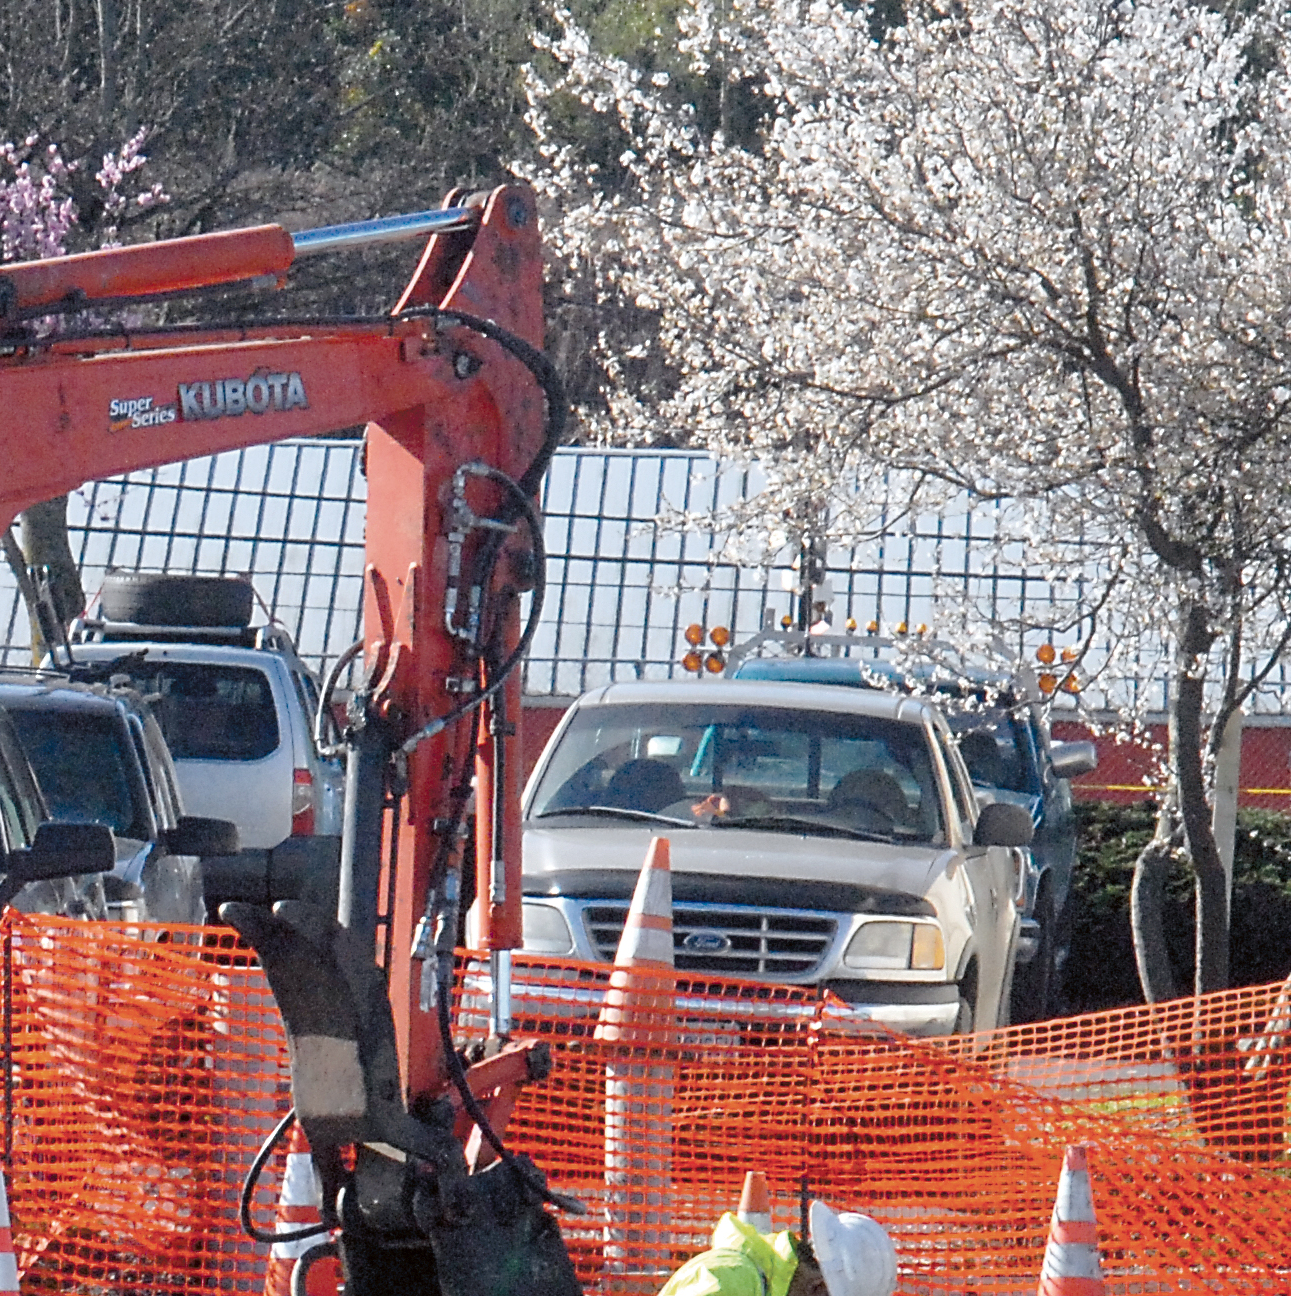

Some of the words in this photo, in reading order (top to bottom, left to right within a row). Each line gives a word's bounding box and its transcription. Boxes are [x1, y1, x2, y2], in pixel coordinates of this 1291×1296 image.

[109, 396, 153, 417] Super
[178, 371, 310, 421] KUBOTA
[131, 407, 176, 429] Series
